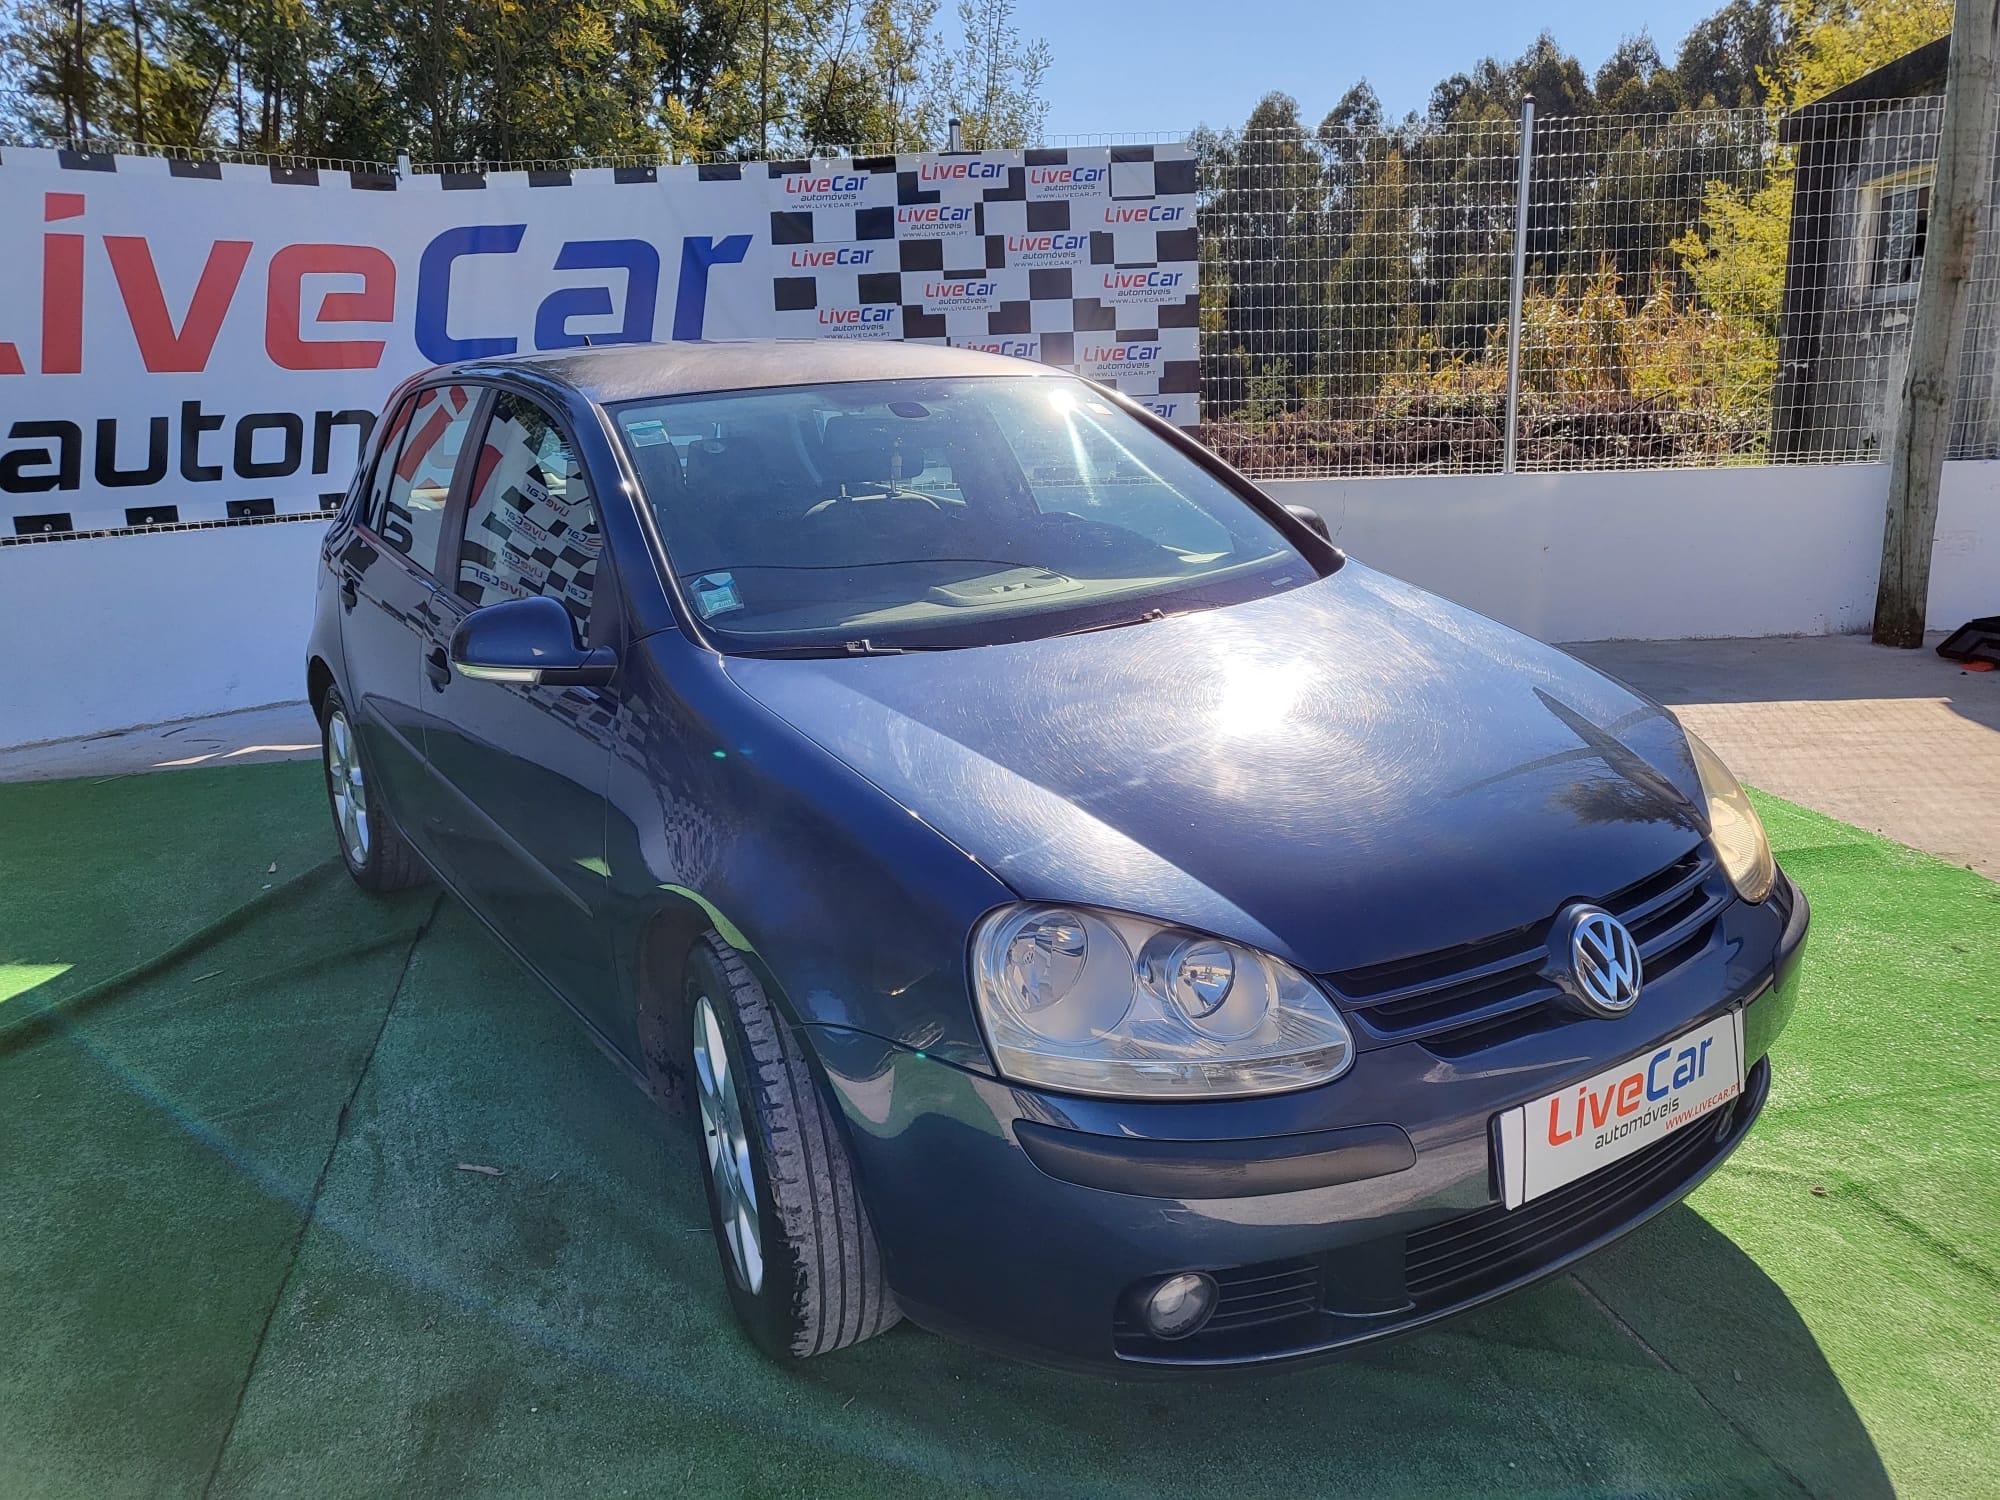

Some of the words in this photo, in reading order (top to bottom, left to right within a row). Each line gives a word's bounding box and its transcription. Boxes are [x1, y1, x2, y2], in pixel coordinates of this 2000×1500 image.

[921, 161, 1005, 181] LiveCar
[1031, 167, 1106, 184] LiveCar
[786, 175, 868, 194] LiveCar
[1044, 182, 1095, 191] automóveis
[800, 192, 857, 201] automóveis
[898, 206, 972, 223] LiveCar
[1105, 205, 1184, 223] LiveCar
[910, 221, 961, 230] automóveis
[1008, 234, 1088, 252] LiveCar
[791, 248, 874, 267] LiveCar
[1022, 250, 1076, 260] automóveis
[0, 192, 753, 375] iveCar
[1103, 271, 1183, 289] LiveCar
[925, 281, 998, 298] LiveCar
[1117, 286, 1171, 296] automóveis
[938, 296, 987, 305] automóveis
[819, 307, 895, 324] LiveCar
[832, 322, 884, 332] automóveis
[1083, 345, 1162, 362] LiveCar
[1096, 361, 1150, 370] automóveis
[1548, 1035, 1714, 1146] LiveCar
[1594, 1097, 1680, 1150] automóveis
